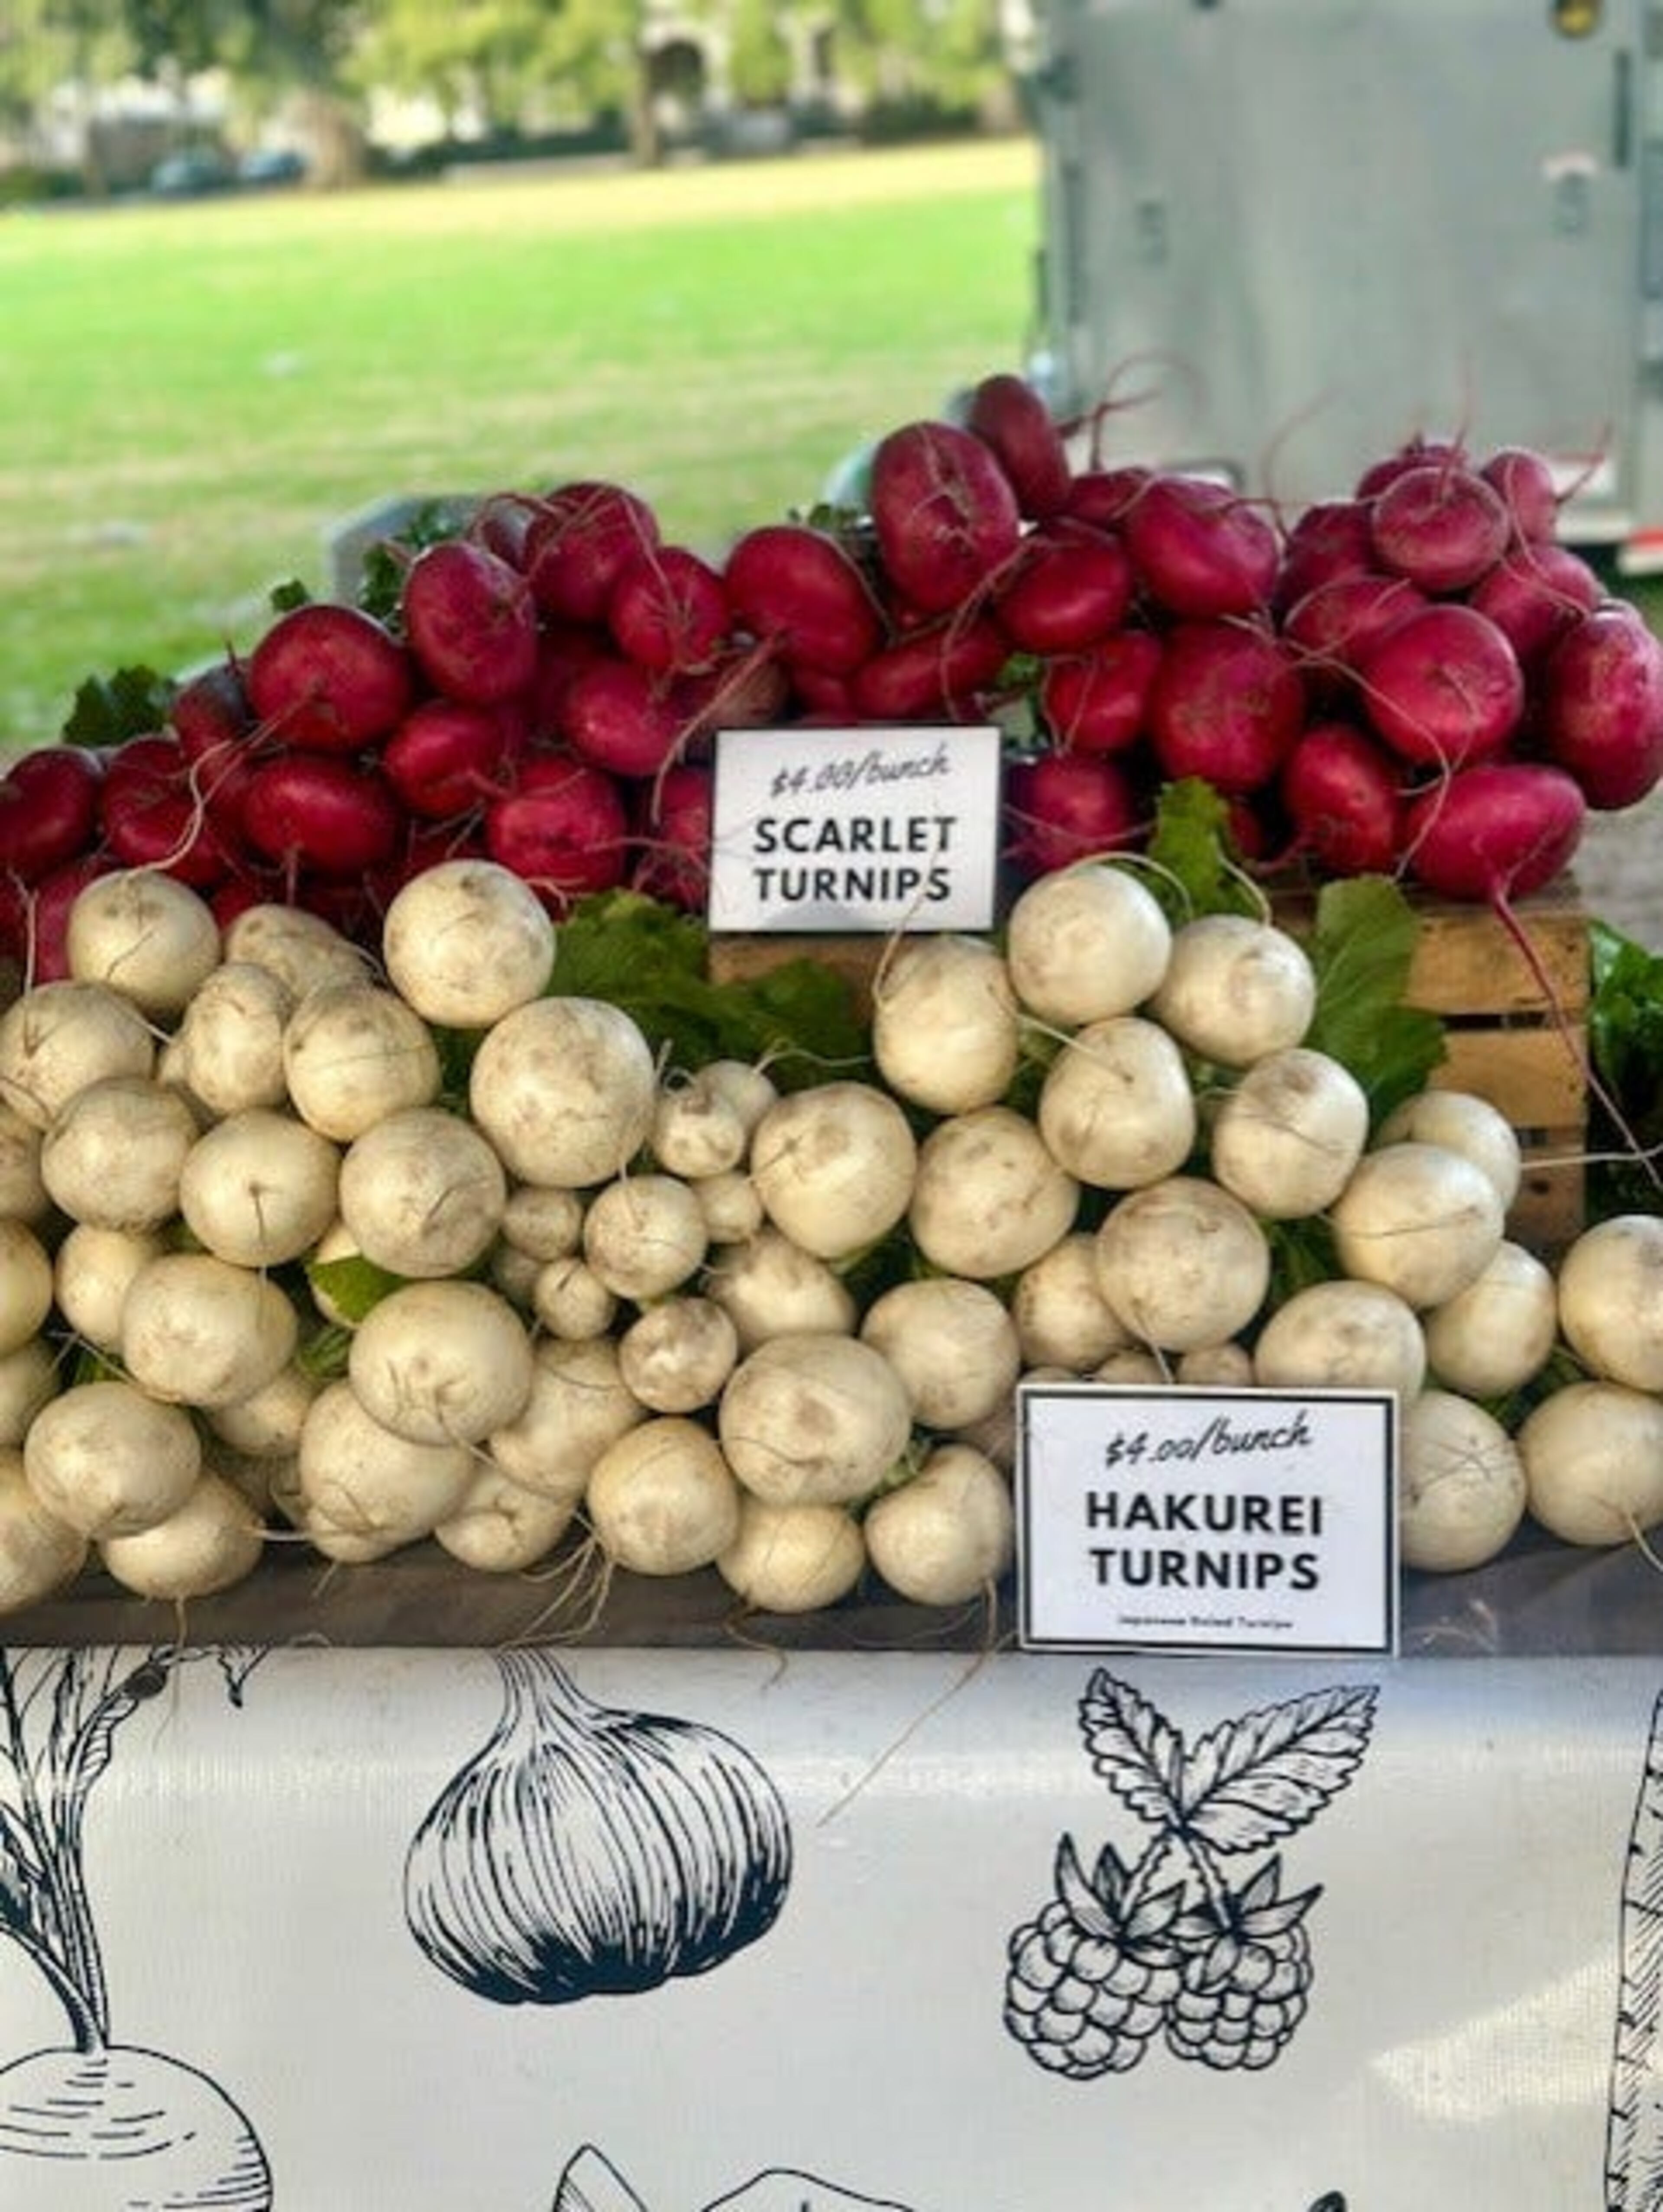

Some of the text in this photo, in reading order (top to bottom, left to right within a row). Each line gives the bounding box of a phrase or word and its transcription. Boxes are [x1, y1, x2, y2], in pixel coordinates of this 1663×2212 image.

[754, 817, 957, 853] SCARLET
[755, 868, 950, 901] TURNIPS
[1106, 1409, 1311, 1467] $4.00/bunch
[1087, 1491, 1322, 1536] HAKUREI
[1089, 1549, 1319, 1591] TURNIPS
